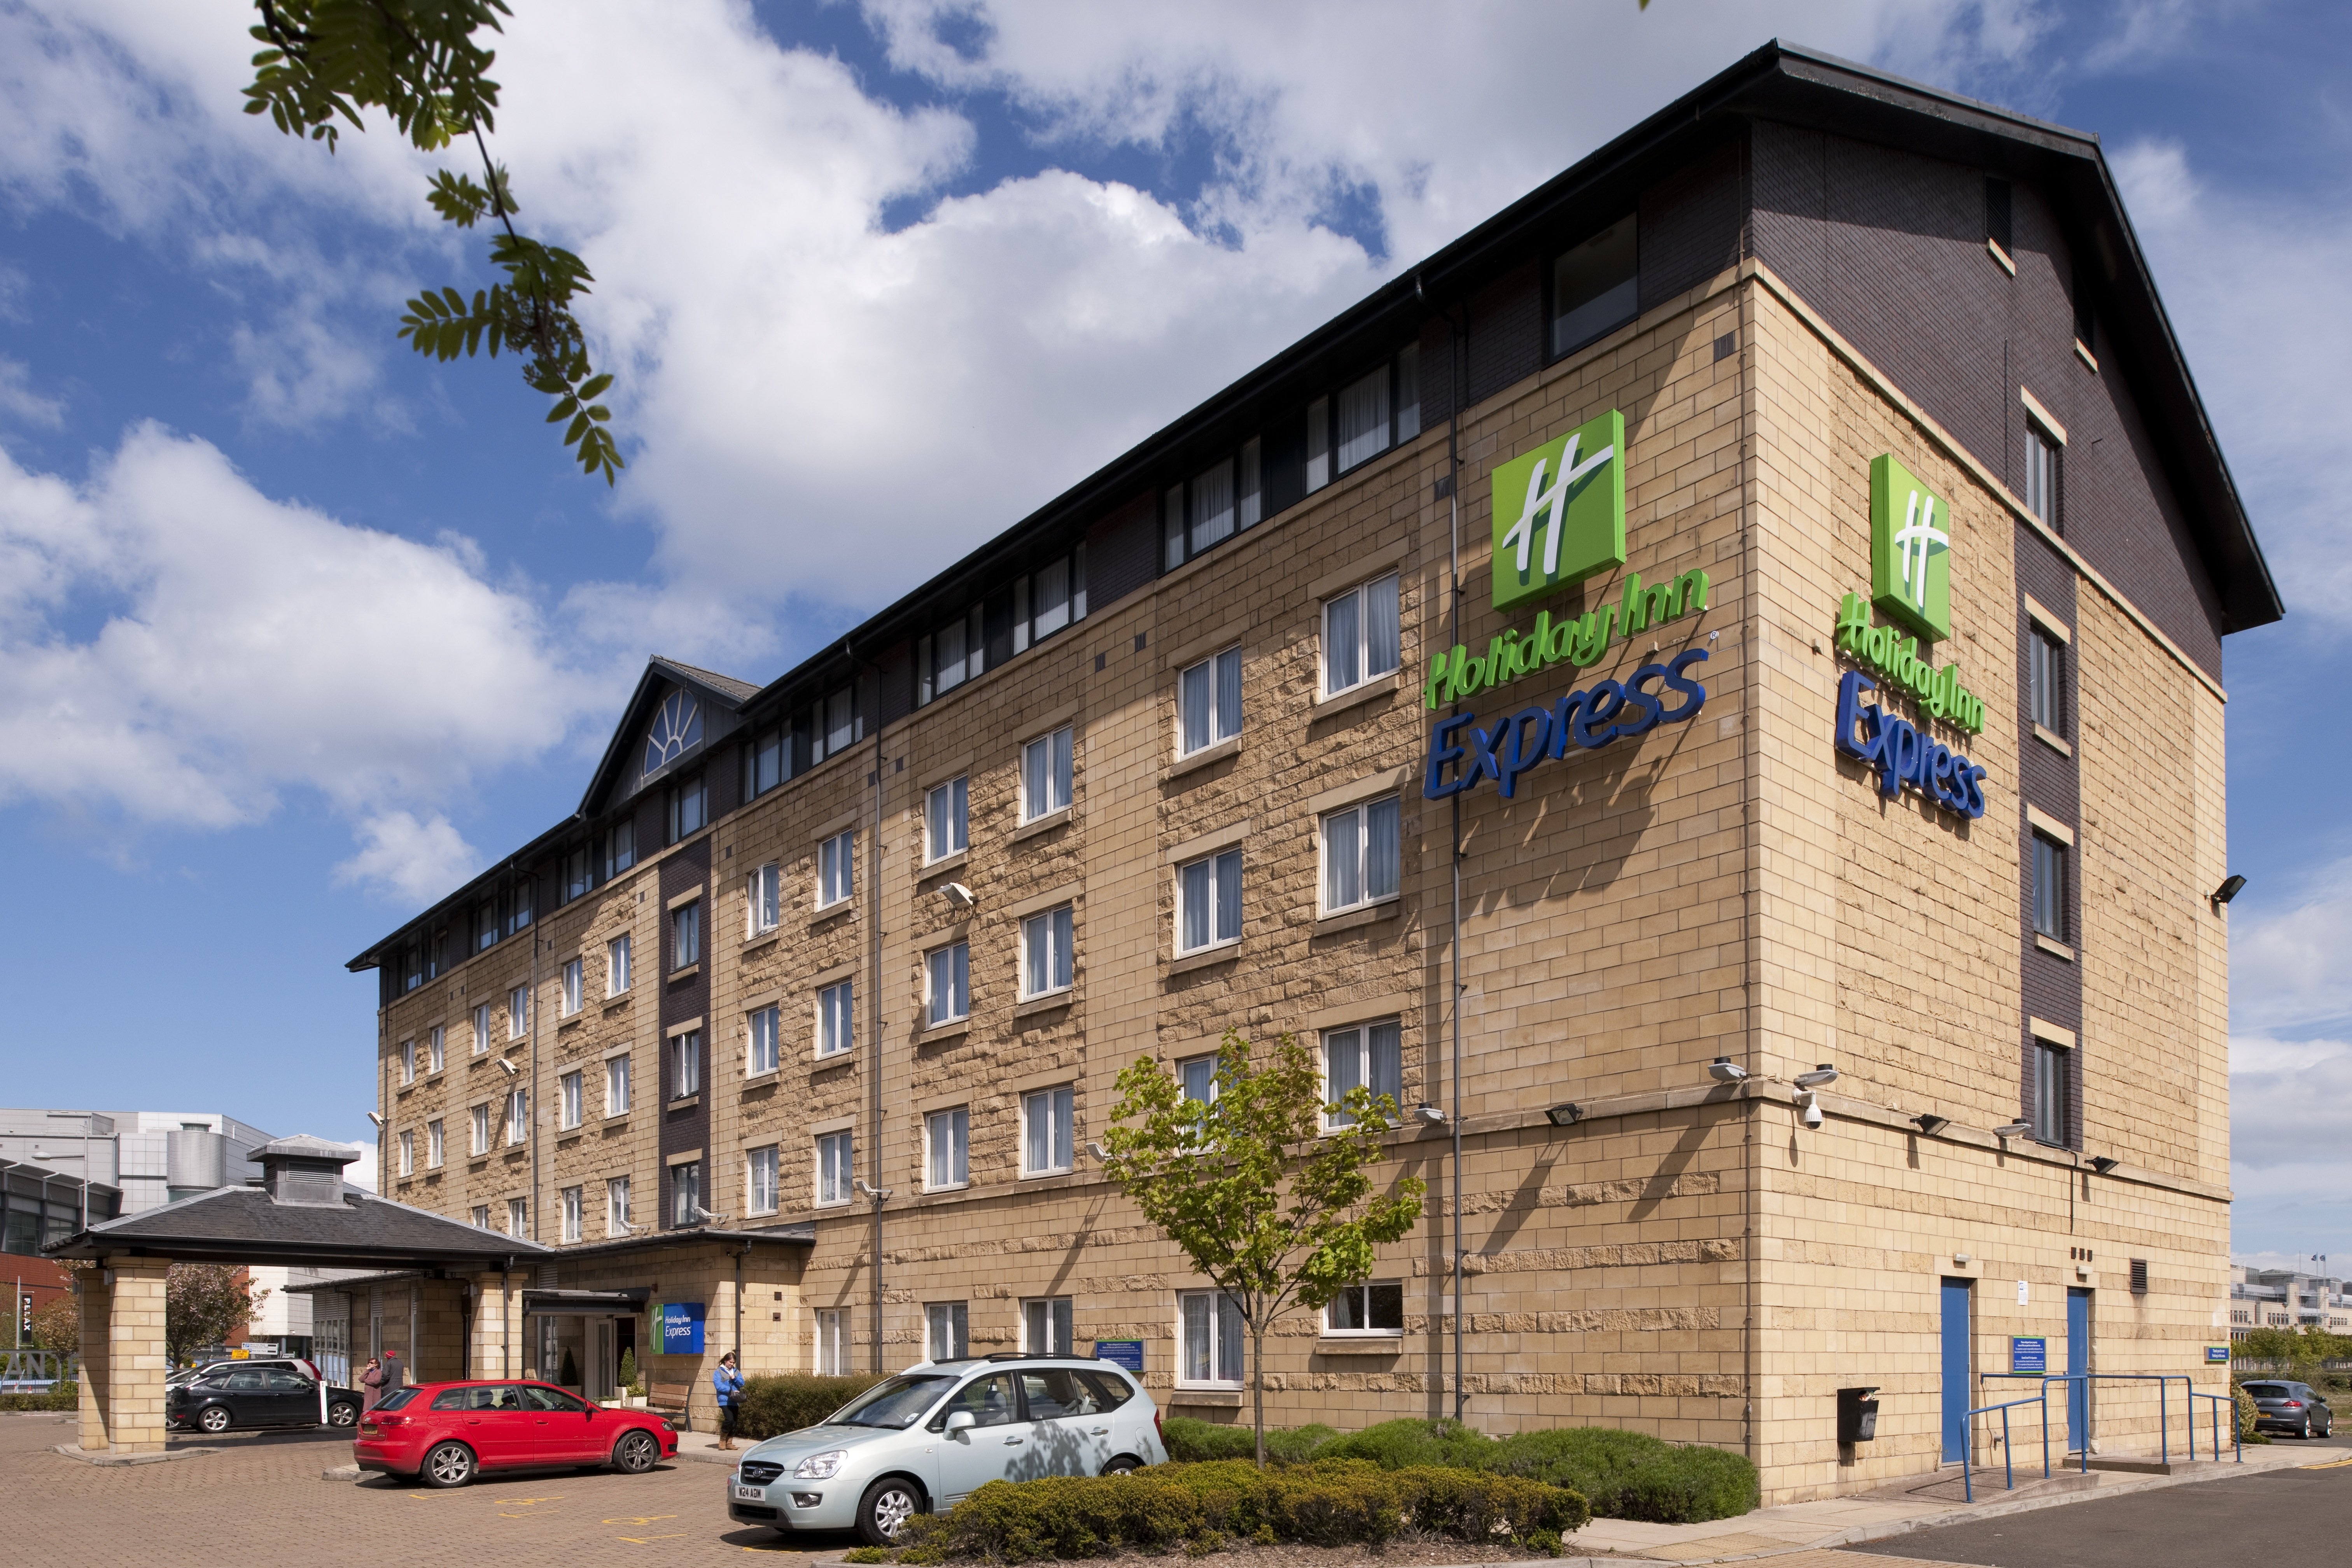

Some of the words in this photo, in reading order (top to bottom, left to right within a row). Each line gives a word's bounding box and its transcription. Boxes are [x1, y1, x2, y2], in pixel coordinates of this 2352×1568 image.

[1423, 604, 1615, 710] Holiday
[1617, 569, 1709, 637] Inn
[1836, 592, 1946, 720] Holiday
[1944, 664, 1985, 735] Inn
[1423, 648, 1708, 801] Express
[1836, 670, 1986, 821] Express
[665, 1316, 682, 1325] Holiday
[682, 1314, 691, 1323] Inn
[665, 1326, 691, 1339] Express
[750, 1488, 761, 1498] ADM
